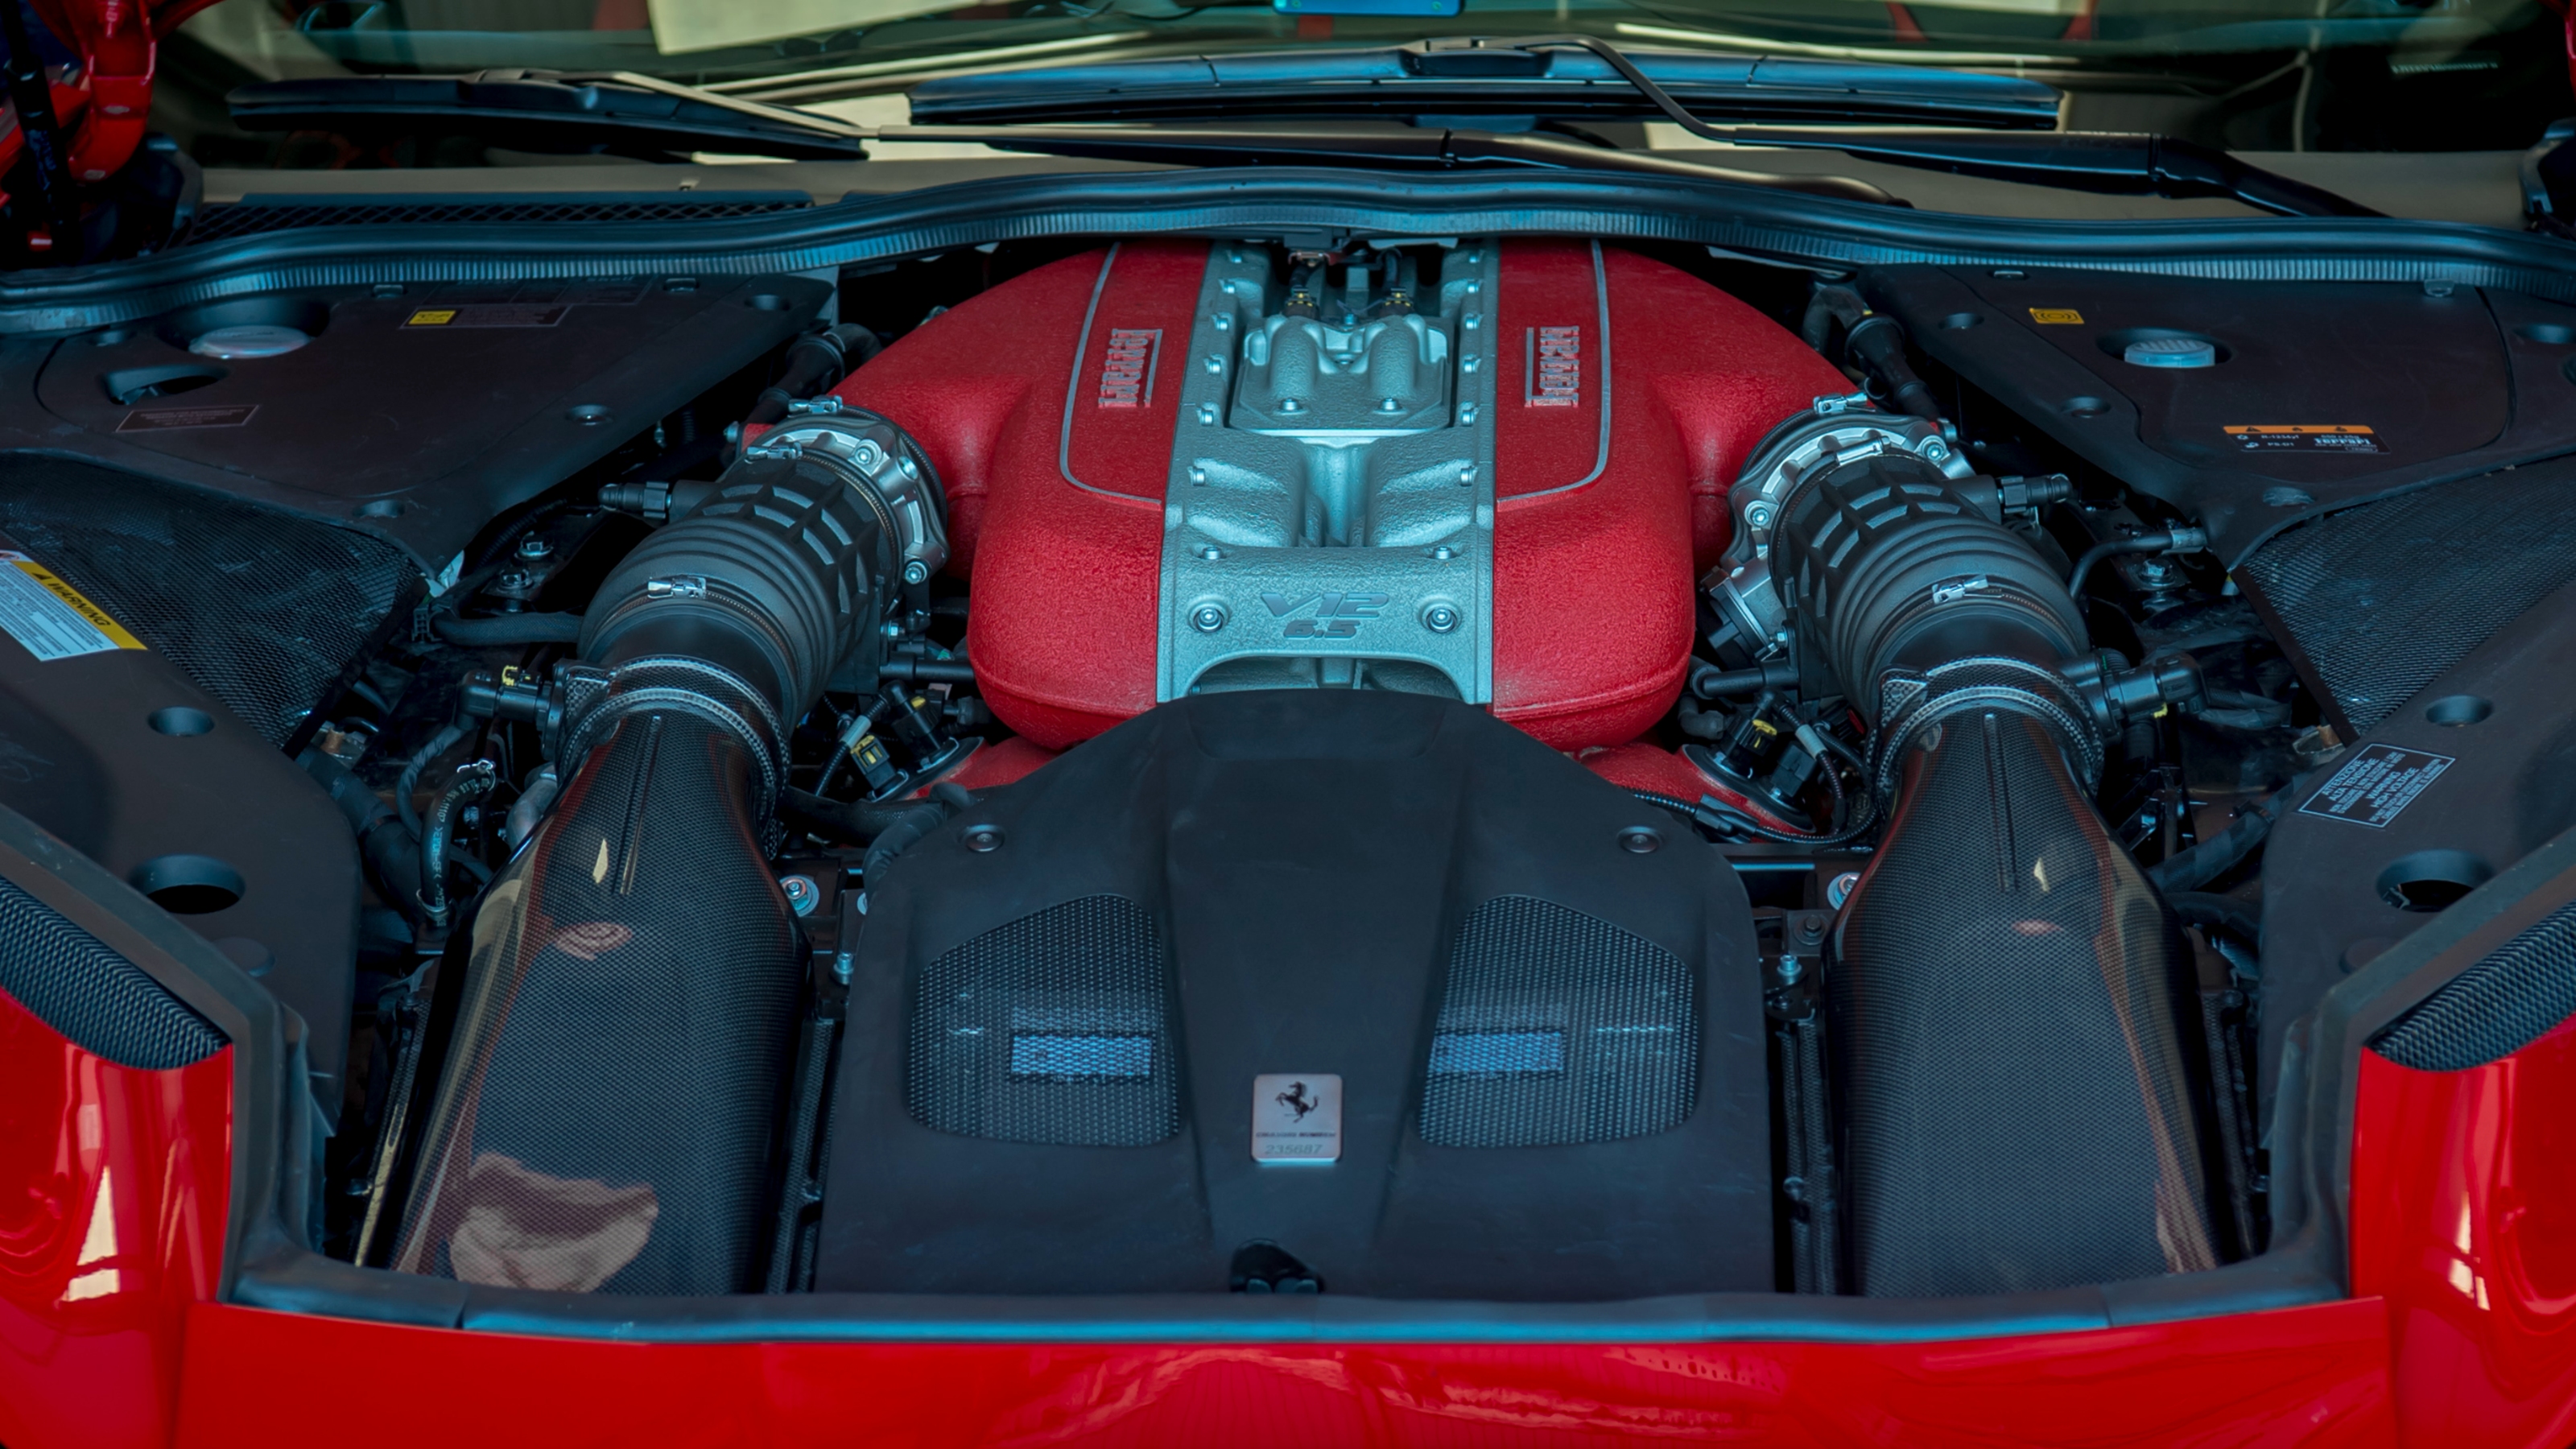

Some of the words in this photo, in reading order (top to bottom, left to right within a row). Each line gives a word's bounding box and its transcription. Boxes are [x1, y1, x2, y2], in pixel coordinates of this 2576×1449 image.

[47, 582, 111, 626] WARNING
[1260, 592, 1390, 617] V12
[1283, 619, 1360, 638] 6.5
[2321, 758, 2365, 795] ATTENZIONE
[2327, 786, 2348, 801] ALTA
[2343, 757, 2380, 786] TENSIONE
[2365, 770, 2402, 799] WARNING
[2369, 791, 2392, 808] HIGH
[2387, 766, 2420, 793] VOLTAGE
